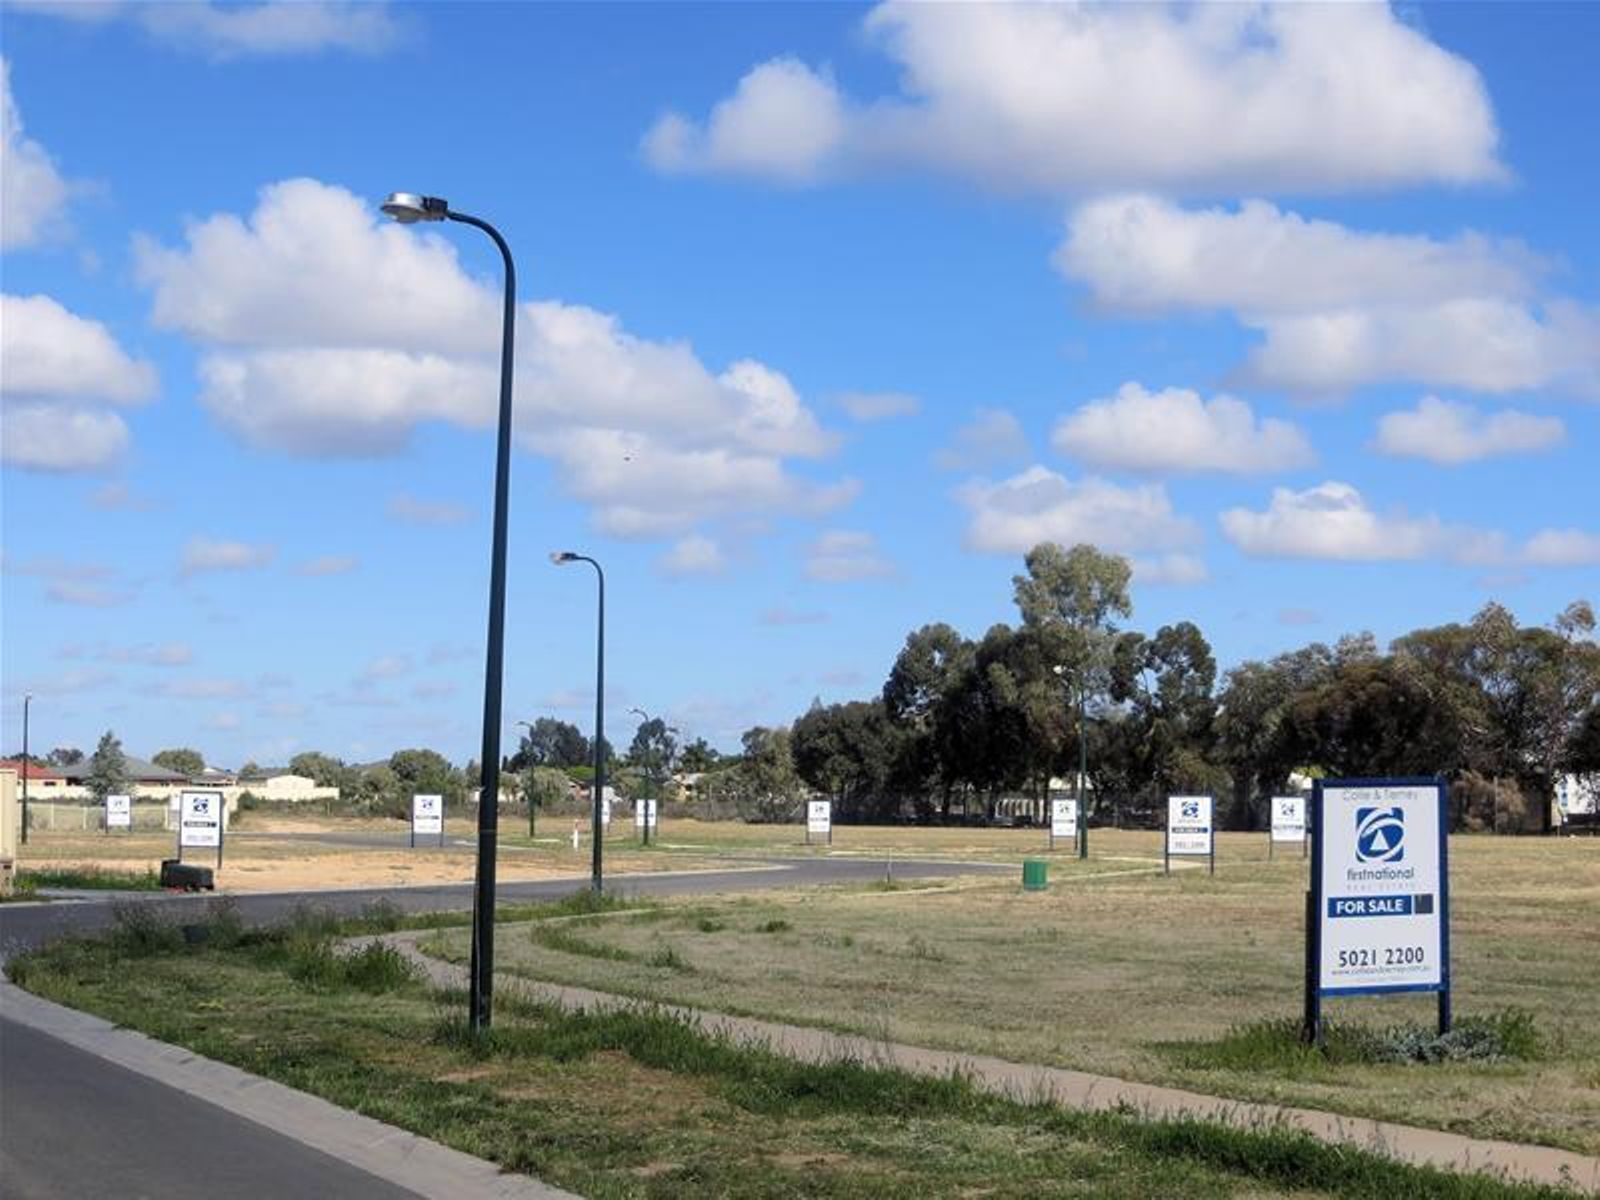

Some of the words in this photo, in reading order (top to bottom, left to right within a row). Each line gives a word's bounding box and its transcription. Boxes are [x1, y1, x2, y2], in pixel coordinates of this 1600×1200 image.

[1346, 867, 1415, 881] firstnational
[1336, 901, 1366, 914] FOR
[1368, 899, 1404, 912] SALE
[1339, 949, 1377, 968] 5021
[1385, 947, 1425, 965] 2200
